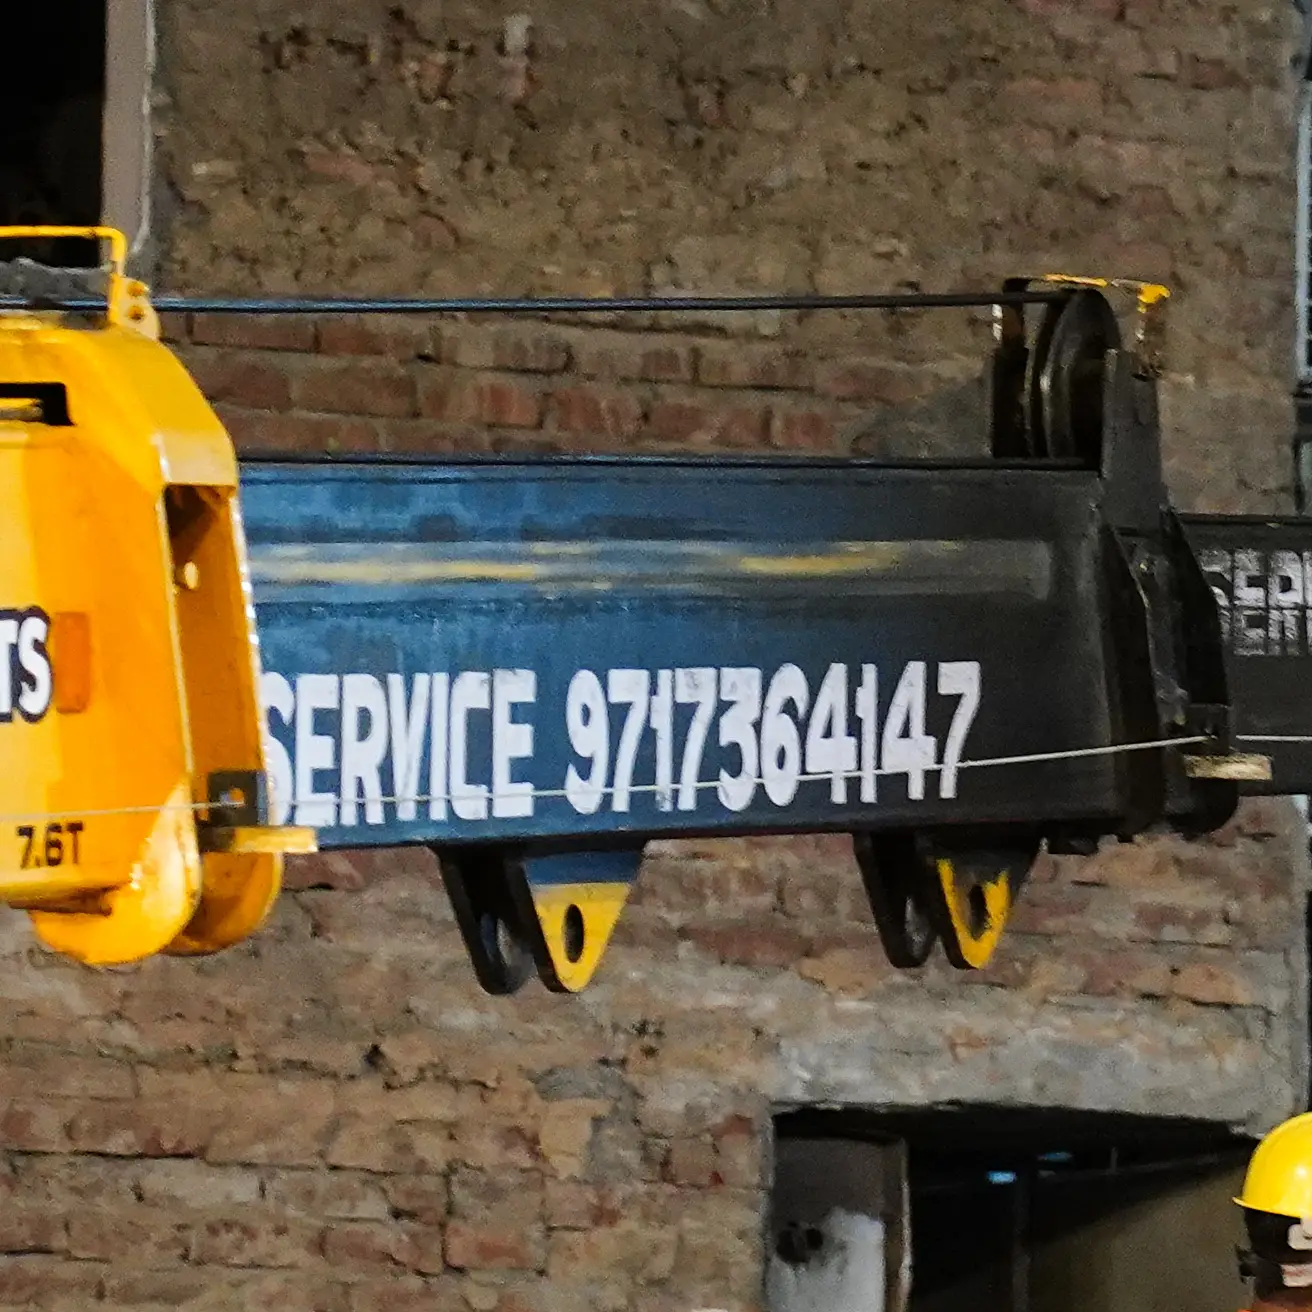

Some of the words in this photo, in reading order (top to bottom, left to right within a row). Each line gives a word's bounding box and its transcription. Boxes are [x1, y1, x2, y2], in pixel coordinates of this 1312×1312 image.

[258, 668, 537, 826] SERVICE
[564, 661, 982, 815] 9717364147
[17, 821, 84, 869] 7.6T
